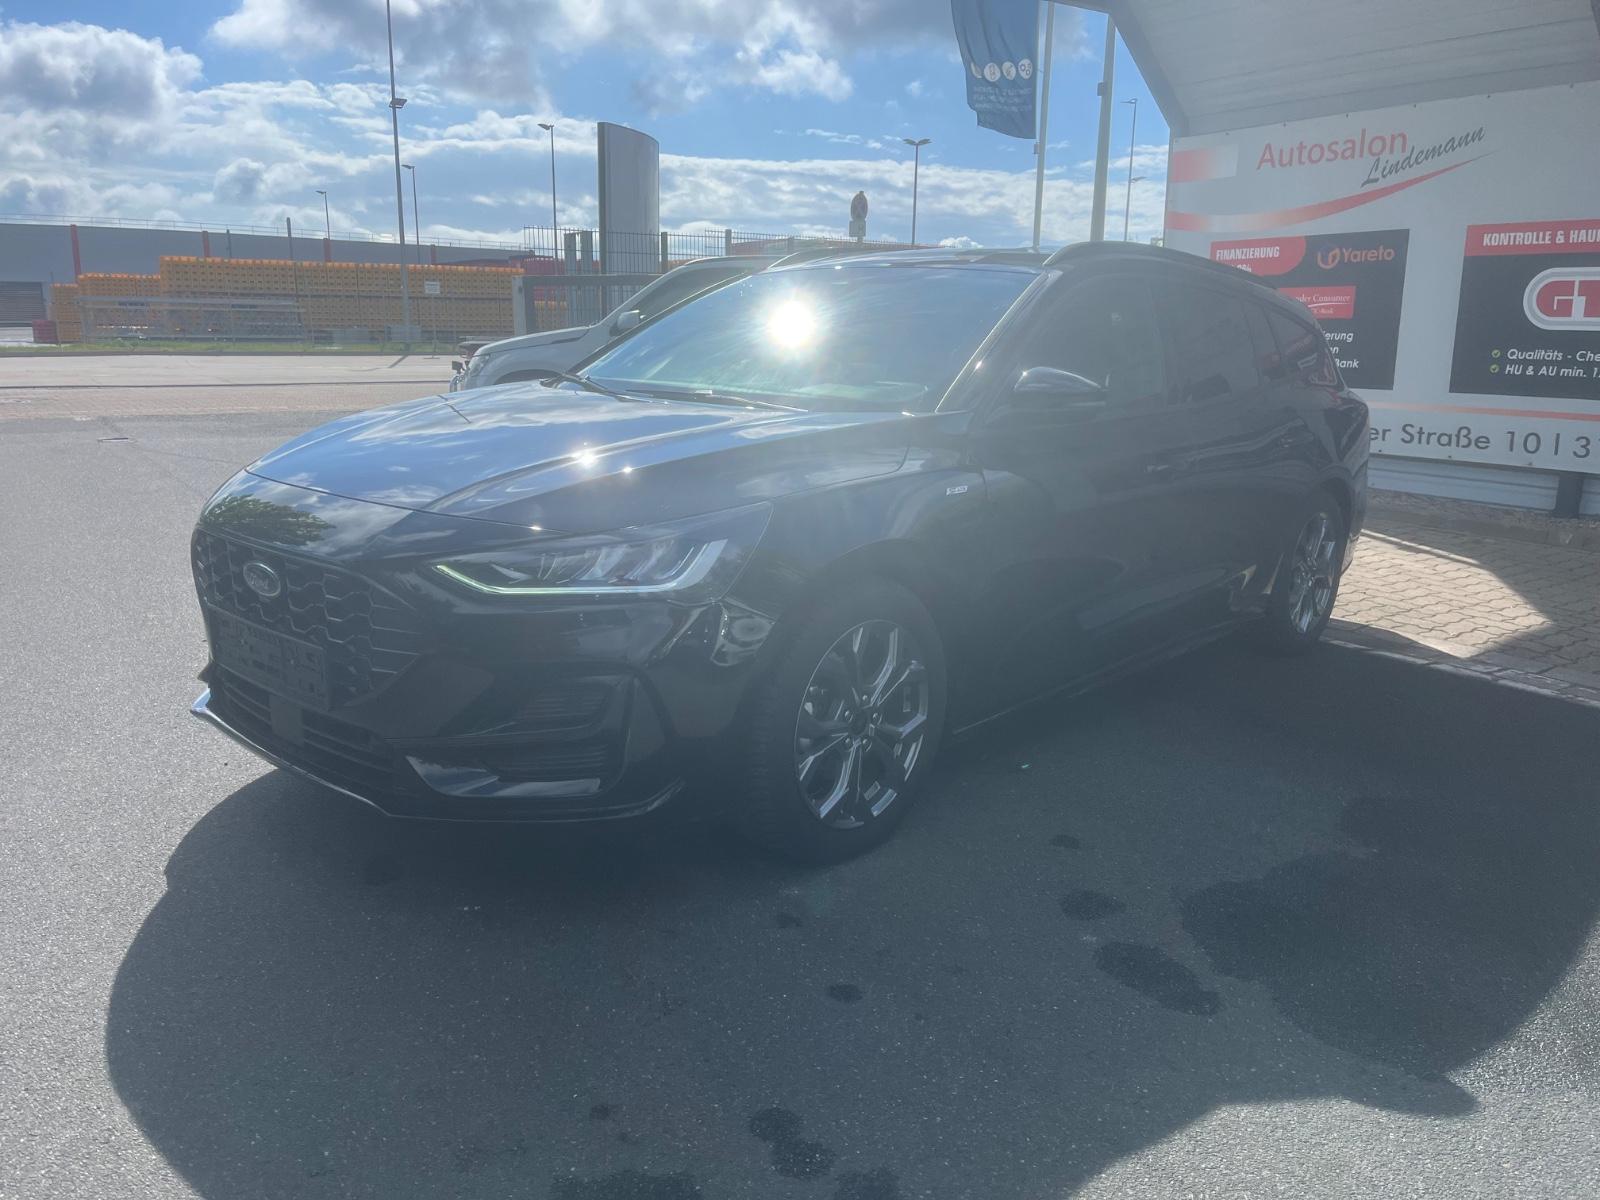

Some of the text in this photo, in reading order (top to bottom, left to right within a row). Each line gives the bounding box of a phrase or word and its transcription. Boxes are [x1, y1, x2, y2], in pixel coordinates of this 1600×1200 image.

[1256, 128, 1408, 170] Autosalon
[1360, 126, 1485, 188] Lindemann
[1483, 231, 1552, 246] KONTROLLE
[1556, 230, 1565, 244] &
[1216, 246, 1280, 261] FINANZIERUNG
[1341, 246, 1395, 263] Yareto
[1507, 349, 1563, 361] Qualitäts
[1505, 364, 1522, 375] HU
[1526, 365, 1534, 375] &
[1538, 366, 1557, 377] AU
[1560, 367, 1587, 378] min.
[1401, 423, 1491, 450] Straße
[1507, 431, 1541, 454] 10
[1572, 436, 1600, 458] 3
